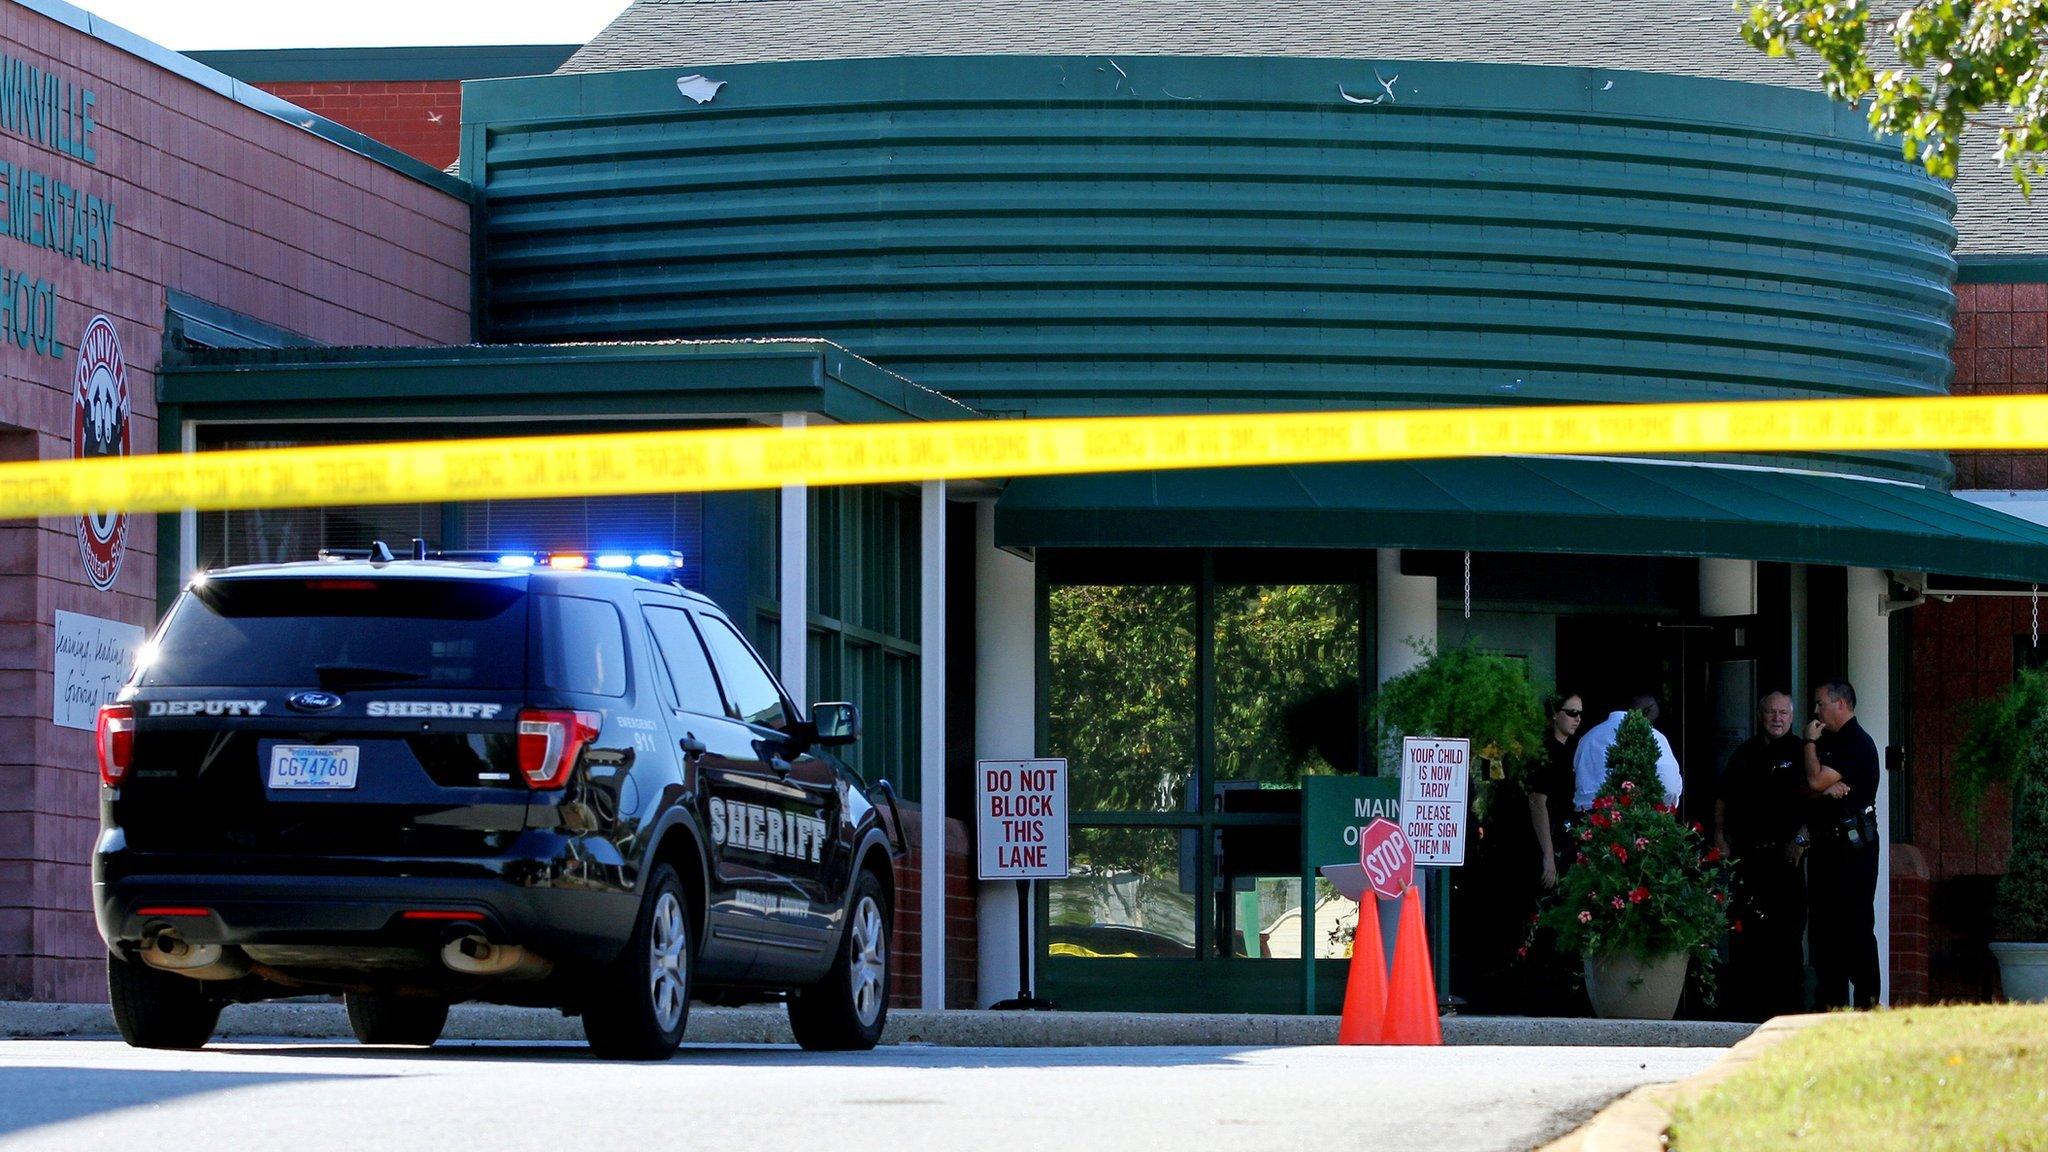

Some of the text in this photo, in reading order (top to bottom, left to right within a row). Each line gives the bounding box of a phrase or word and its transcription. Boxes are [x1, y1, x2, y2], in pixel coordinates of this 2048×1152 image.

[77, 328, 129, 425] TOWNVILLE
[149, 700, 267, 717] DEPUTY
[301, 694, 329, 706] Ford
[366, 701, 502, 720] SHERIFF
[634, 732, 656, 753] 911
[1410, 748, 1463, 764] YOUR CHILD
[278, 757, 349, 777] CG74760
[1418, 765, 1453, 781] IS NOW
[986, 769, 1058, 792] DO NOT
[1420, 782, 1450, 798] TARDY
[991, 794, 1053, 818] BLOCK
[1354, 798, 1400, 818] MAIN
[1416, 805, 1451, 821] PLEASE
[709, 796, 827, 864] SHERIFF
[1001, 820, 1044, 843] THIS
[1407, 822, 1458, 838] COME SIGN
[998, 845, 1048, 868] LANE
[1413, 839, 1451, 855] THEM IN
[1366, 831, 1407, 885] STOP
